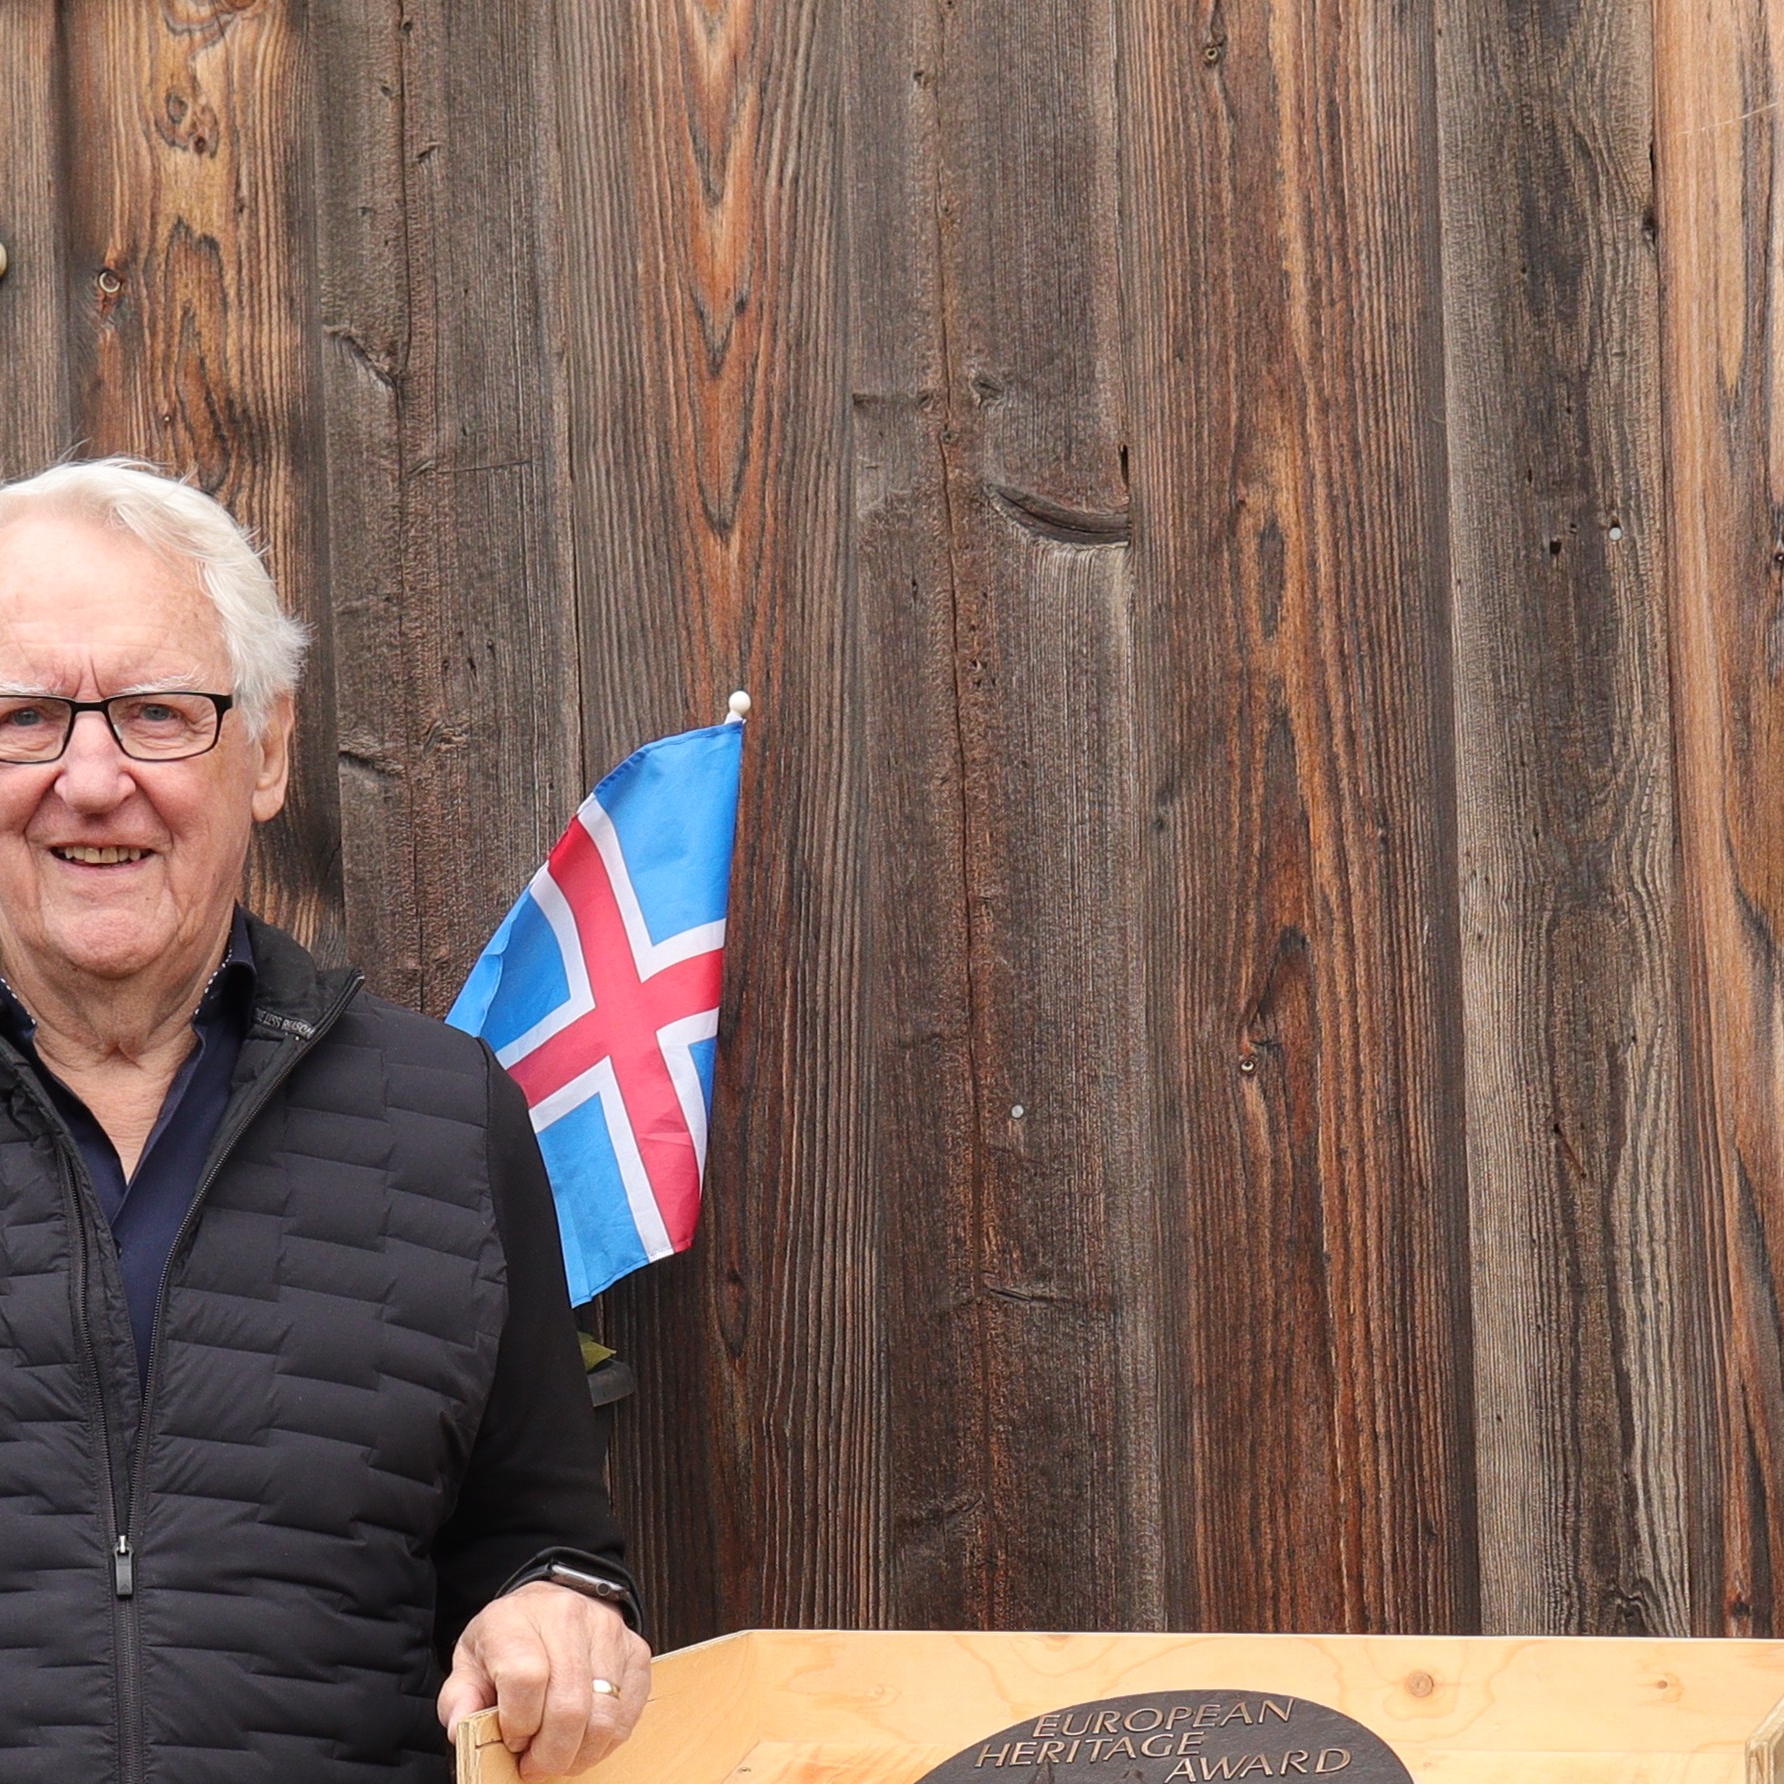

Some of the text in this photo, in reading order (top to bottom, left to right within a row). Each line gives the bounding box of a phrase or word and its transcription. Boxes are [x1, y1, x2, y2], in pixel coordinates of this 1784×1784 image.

[1032, 1698, 1295, 1739] EUROPEAN
[974, 1731, 1206, 1769] HERITAGE
[1164, 1747, 1353, 1784] AWARD
